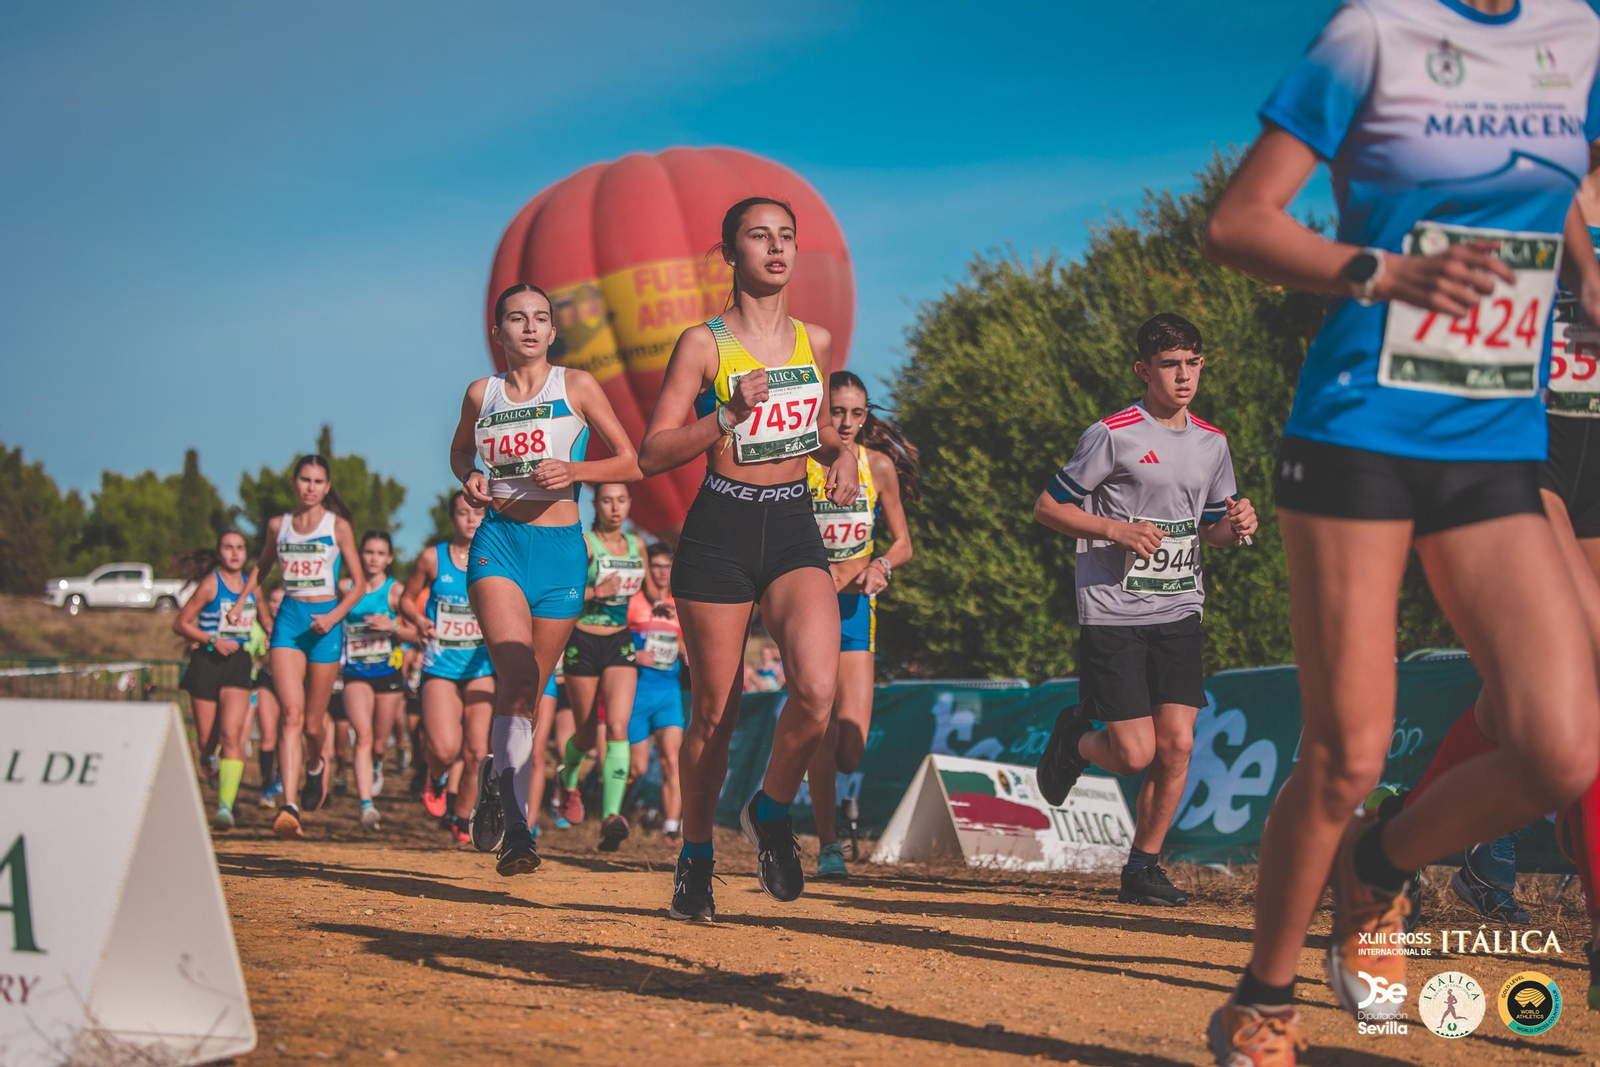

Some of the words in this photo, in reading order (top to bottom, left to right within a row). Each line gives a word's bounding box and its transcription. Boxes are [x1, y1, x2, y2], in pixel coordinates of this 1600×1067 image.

[1425, 112, 1584, 138] MARACEN
[768, 370, 798, 384] ÁLICA
[749, 397, 818, 436] 7457
[482, 429, 546, 461] 7488
[705, 475, 757, 500] NIKE
[758, 483, 804, 502] PRO
[818, 522, 867, 543] 476
[282, 560, 323, 576] 7487
[42, 751, 103, 786] DE
[1049, 800, 1132, 848] ITÁLICA
